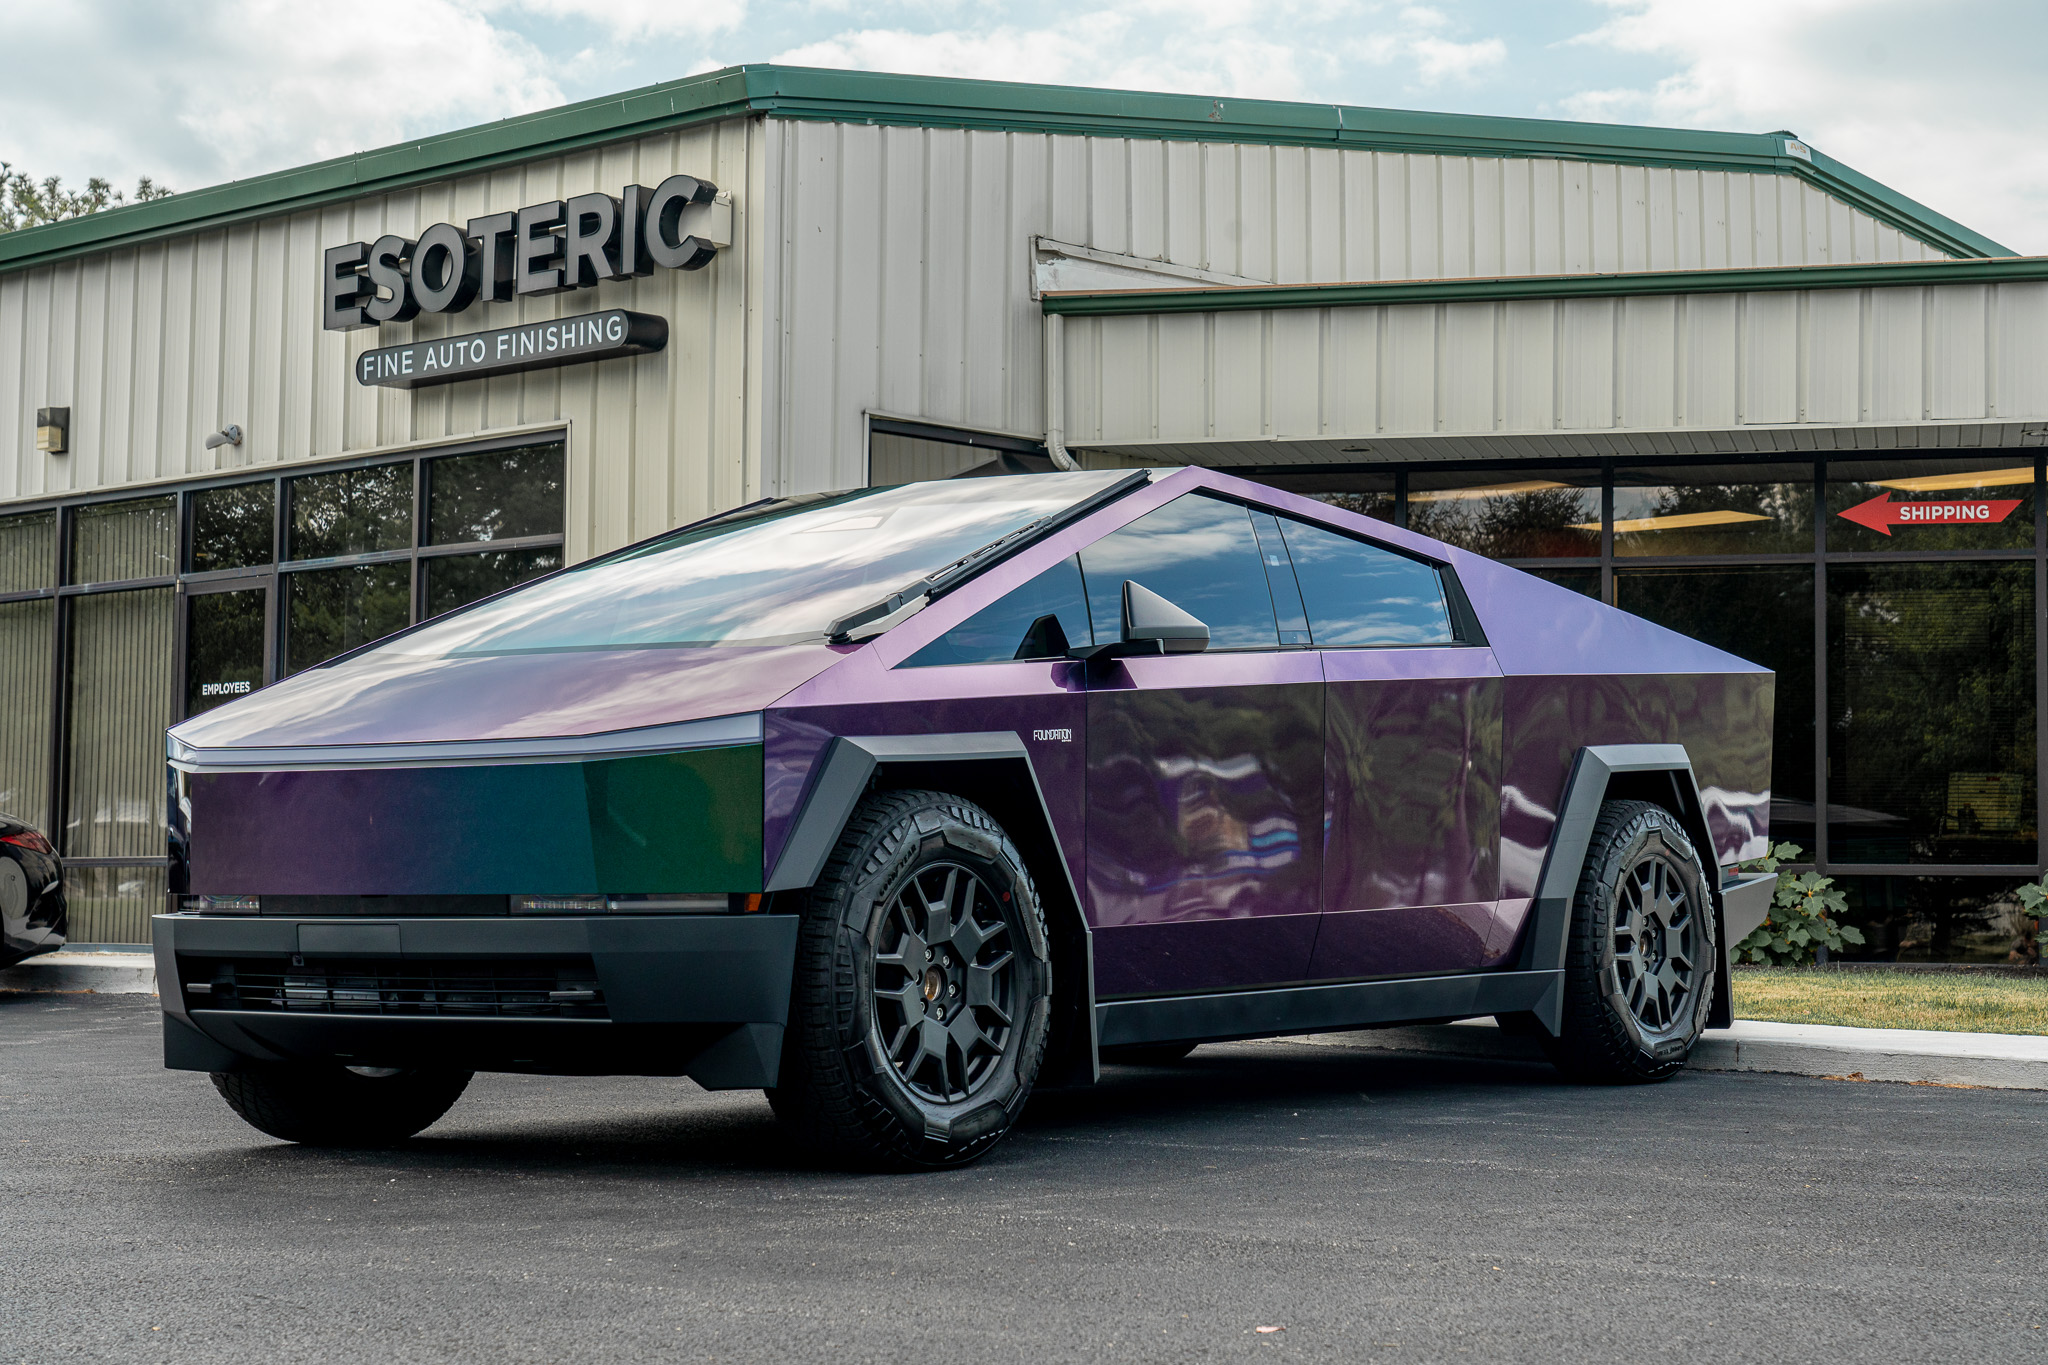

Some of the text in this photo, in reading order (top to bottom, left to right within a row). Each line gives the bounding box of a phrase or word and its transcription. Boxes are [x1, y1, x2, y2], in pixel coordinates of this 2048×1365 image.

[324, 174, 718, 331] ESOTERIC
[363, 315, 623, 380] FINE AUTO FINISHING
[1900, 505, 1990, 520] SHIPPING
[202, 681, 251, 696] EMPLOYEES
[1033, 729, 1072, 741] FOUNDATION
